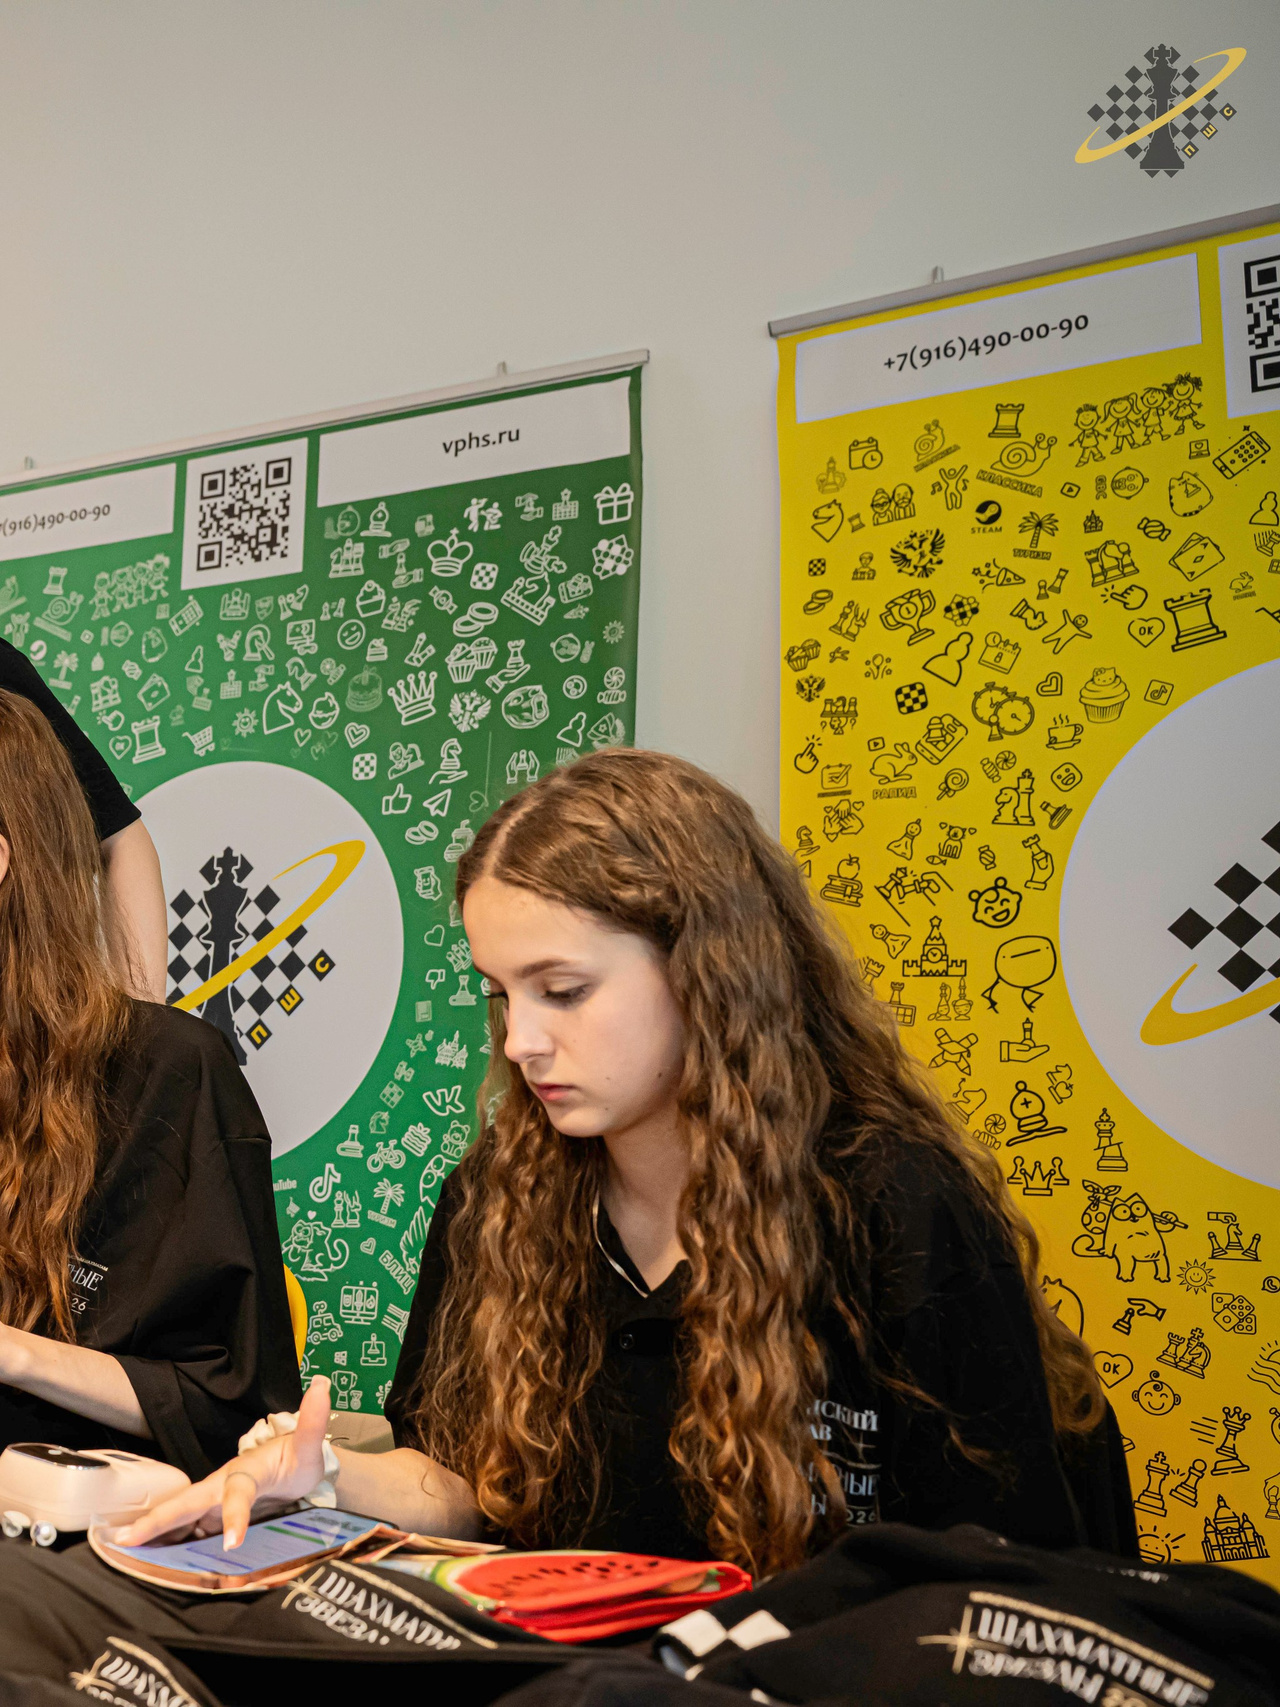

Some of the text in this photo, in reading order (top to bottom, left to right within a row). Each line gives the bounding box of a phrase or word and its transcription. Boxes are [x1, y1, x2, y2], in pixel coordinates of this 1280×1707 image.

[884, 314, 1089, 372] +7(916)490-00-90
[442, 428, 520, 457] vphs.ru
[976, 469, 1043, 498] КЛАССИКА
[970, 526, 1003, 535] STEAM
[1138, 626, 1154, 636] OK
[872, 786, 917, 800] РАПИД
[272, 1177, 298, 1192] uTube
[378, 1249, 416, 1295] БЛИЦ
[71, 1297, 87, 1311] 26
[1103, 1361, 1120, 1375] OK
